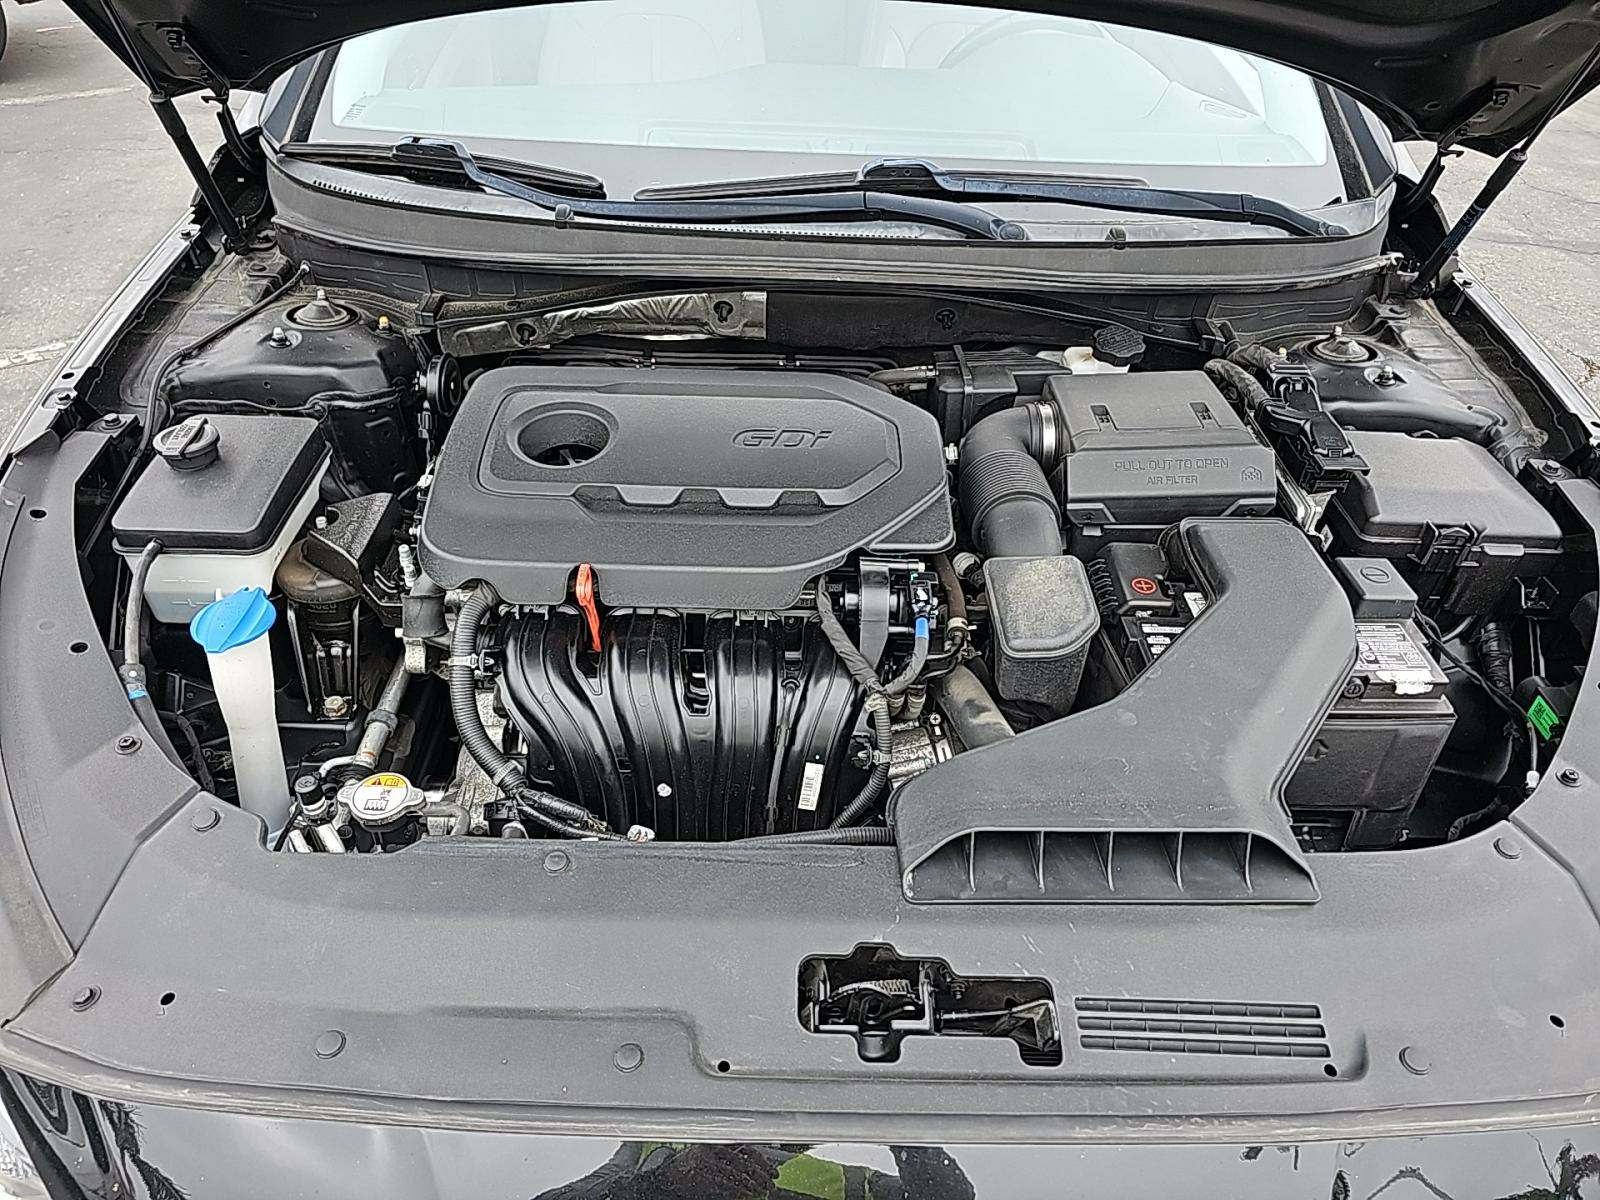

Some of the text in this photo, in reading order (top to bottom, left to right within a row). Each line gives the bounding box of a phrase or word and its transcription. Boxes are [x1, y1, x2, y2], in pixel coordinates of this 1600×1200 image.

[1114, 457, 1230, 471] PULL OUT TO OPEN
[1146, 474, 1199, 486] AIR FILTER
